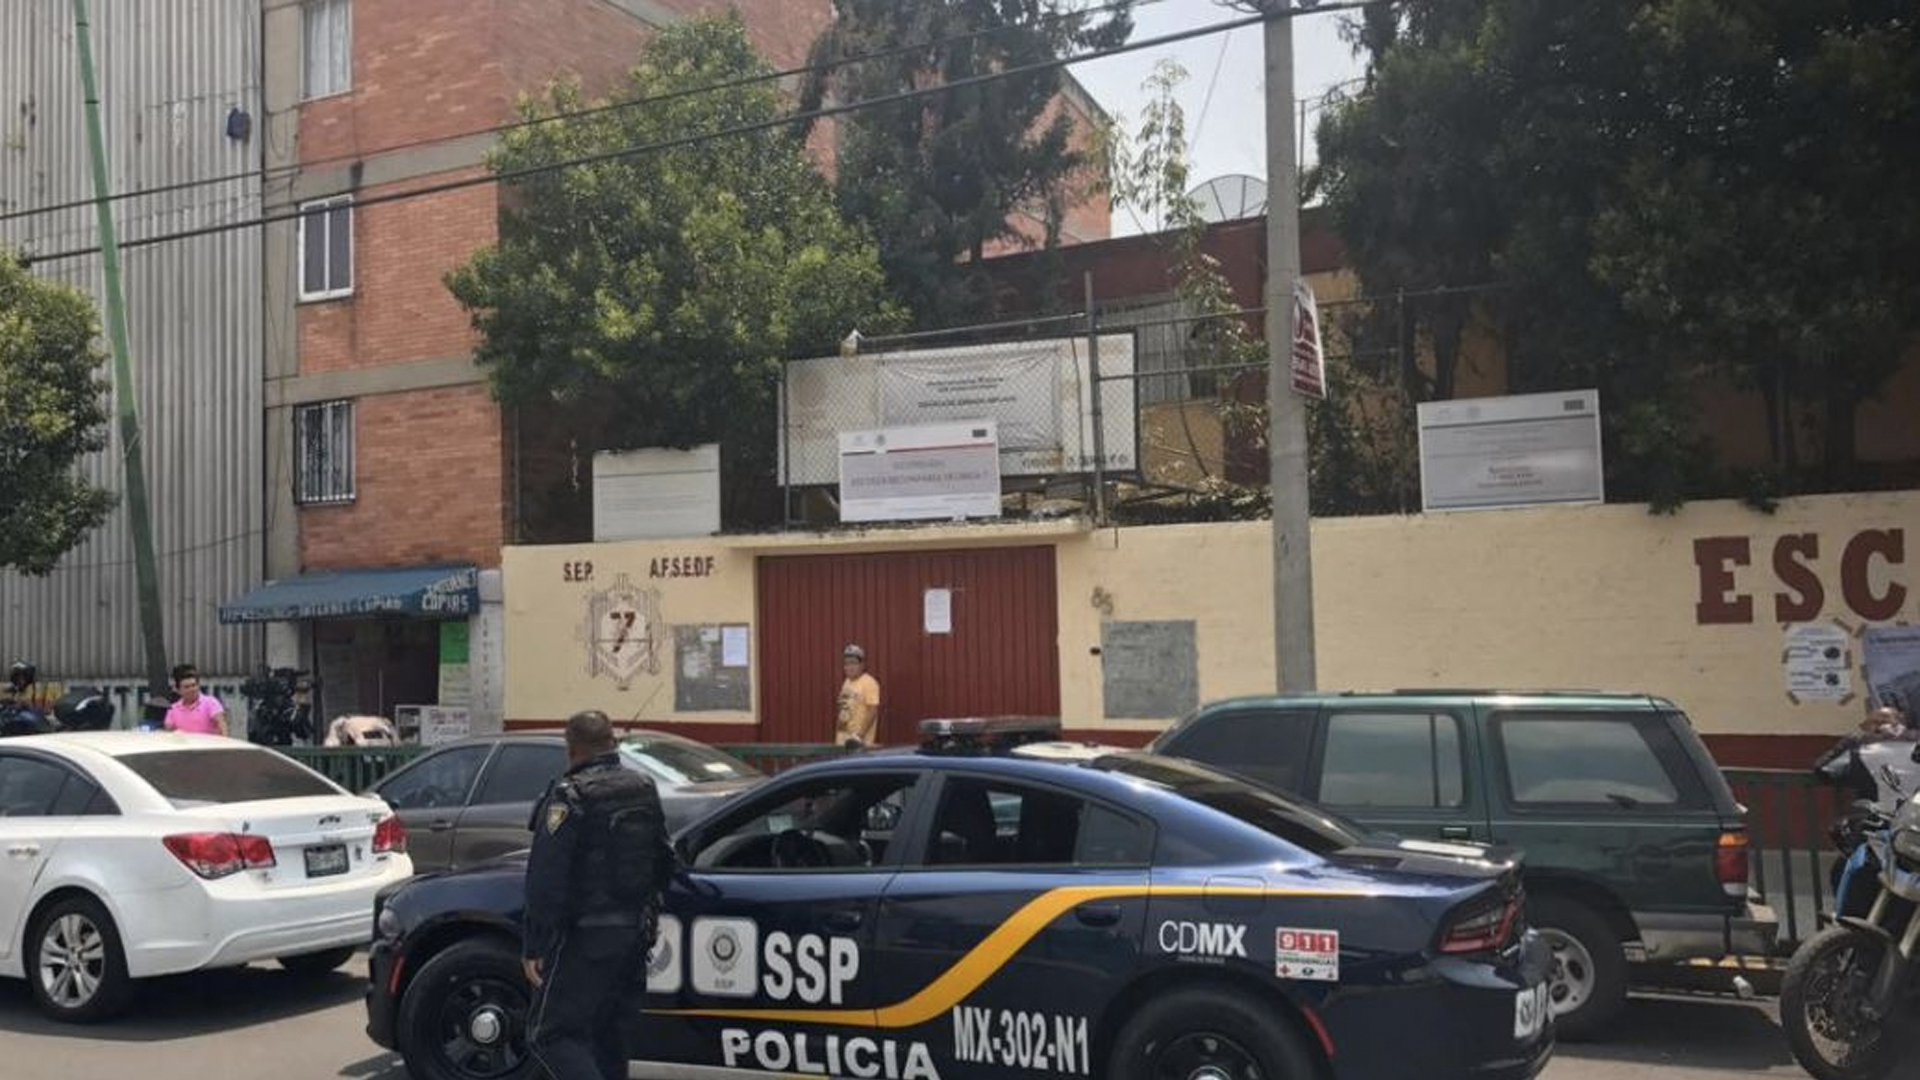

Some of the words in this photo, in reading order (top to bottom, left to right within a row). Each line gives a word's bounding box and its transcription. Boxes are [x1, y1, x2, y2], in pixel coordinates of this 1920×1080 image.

[1693, 527, 1908, 625] ESC
[763, 931, 859, 1004] SSP
[1158, 919, 1247, 958] CDMX
[1282, 934, 1332, 950] 911
[721, 1029, 941, 1080] POLICIA
[953, 1005, 1090, 1075] MX-302-N1
